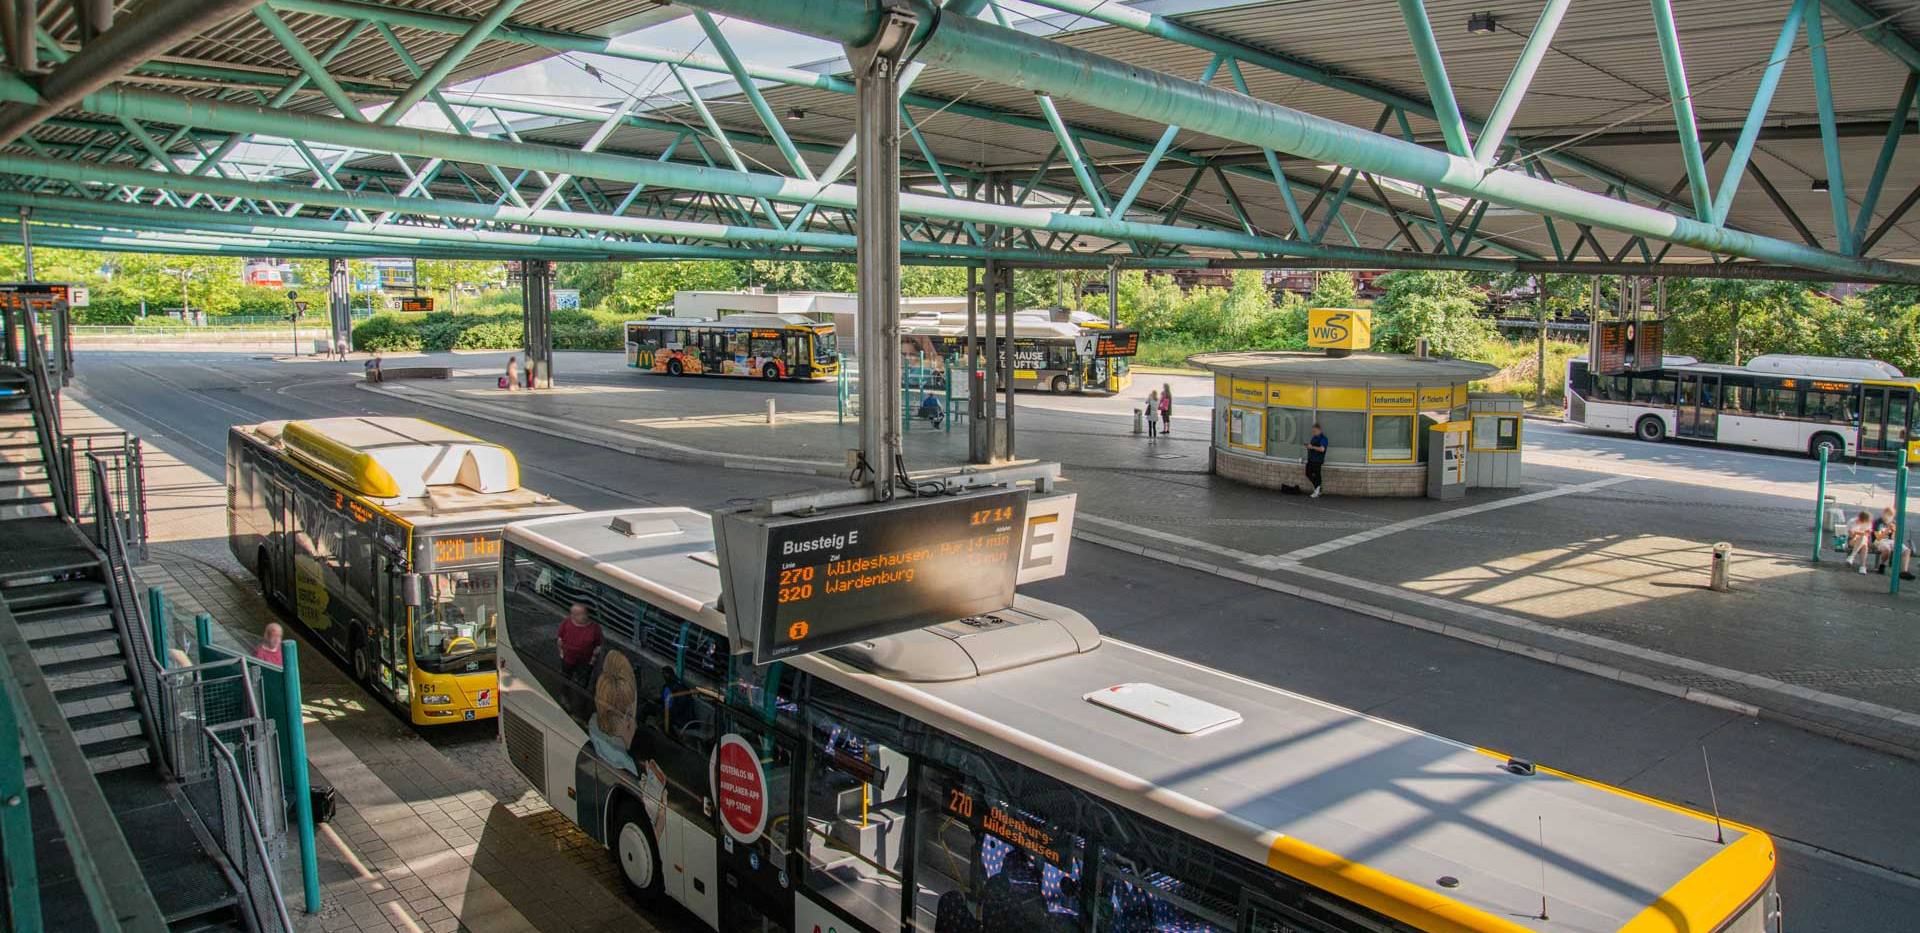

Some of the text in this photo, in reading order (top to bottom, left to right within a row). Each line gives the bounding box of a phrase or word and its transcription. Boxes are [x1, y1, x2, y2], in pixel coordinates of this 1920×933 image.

[74, 291, 83, 303] F
[1084, 339, 1093, 352] A
[1312, 327, 1338, 340] VWG
[1375, 396, 1412, 404] Information
[436, 538, 464, 563] 320
[783, 531, 858, 555] Bussteig E
[1022, 512, 1059, 570] E
[780, 566, 814, 585] 270
[827, 548, 934, 577] Wildeshausen,
[778, 584, 812, 604] 320
[825, 568, 914, 594] Wardenburg
[419, 683, 436, 693] 151
[949, 788, 972, 818] 270
[984, 815, 1060, 863] Wildeshausen
